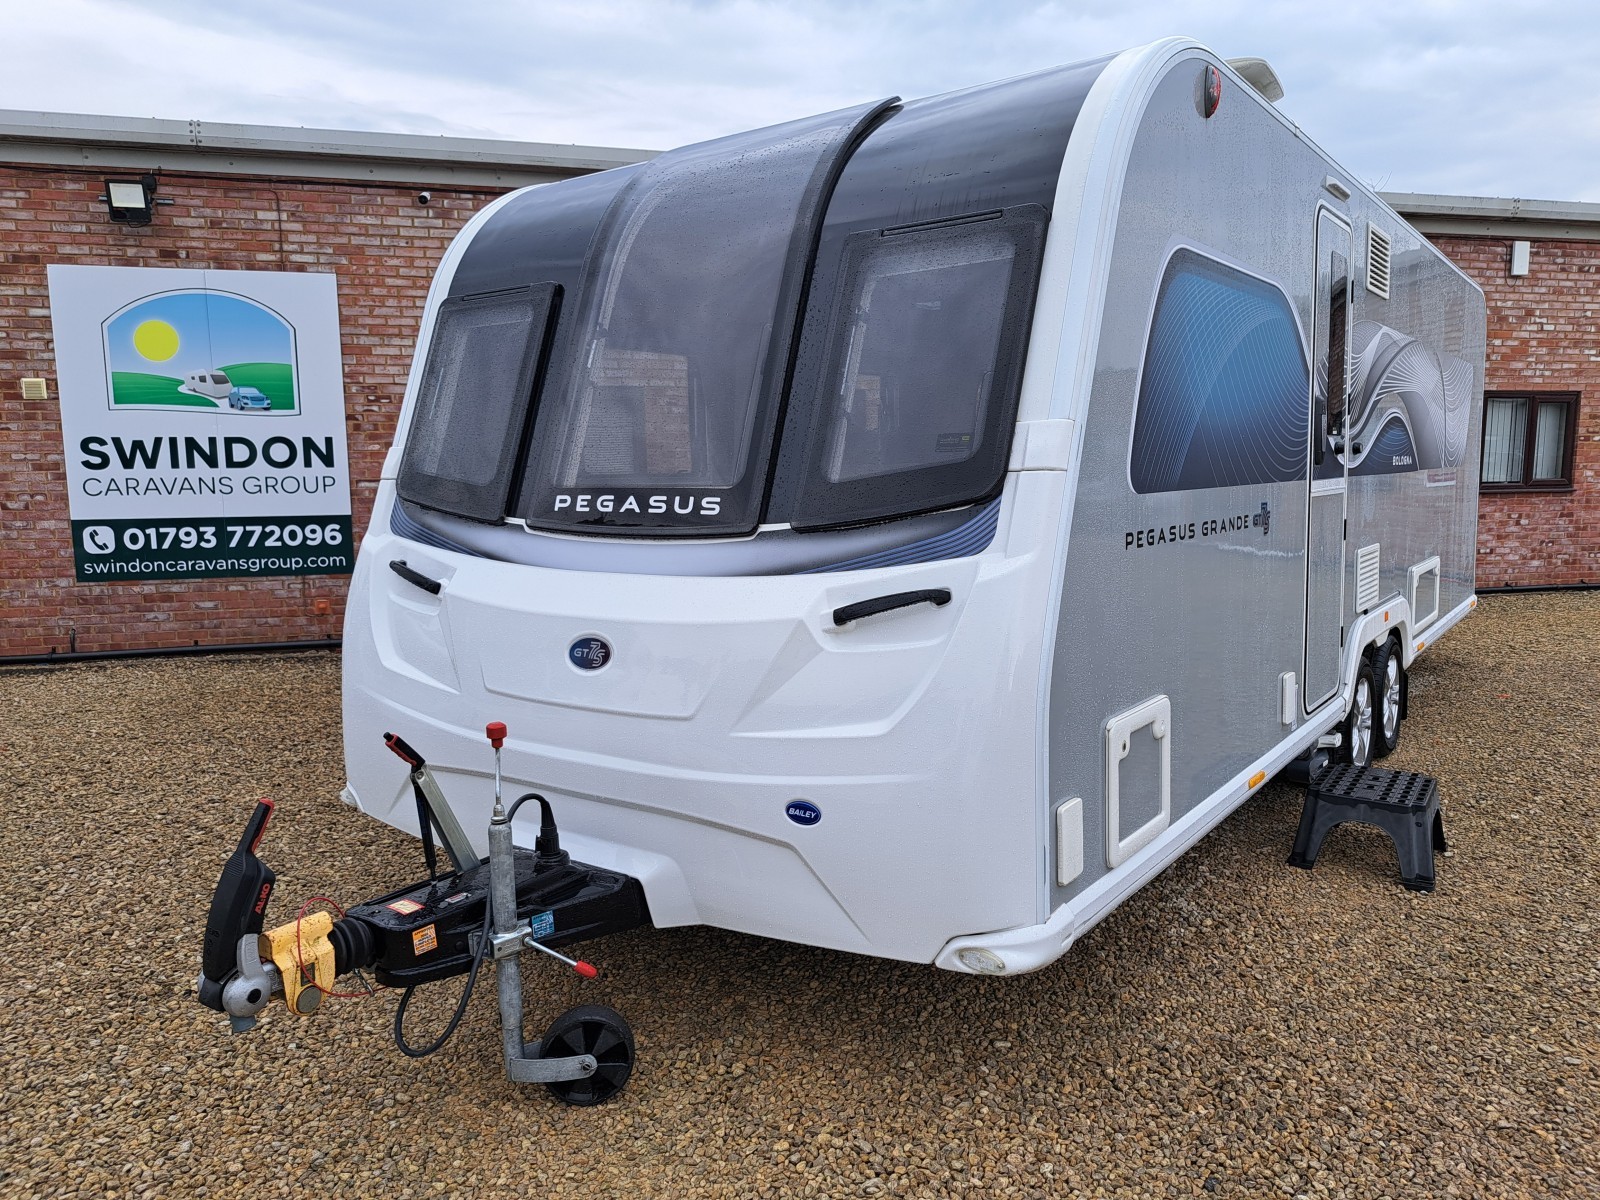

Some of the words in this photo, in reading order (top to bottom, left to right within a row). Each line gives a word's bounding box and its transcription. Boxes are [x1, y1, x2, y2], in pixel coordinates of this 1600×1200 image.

[79, 436, 335, 470] SWINDON
[1392, 455, 1413, 466] BOLOGNA
[82, 476, 234, 497] CARAVANS
[242, 475, 336, 495] GROUP
[554, 494, 721, 516] PEGASUS
[123, 526, 217, 551] 01793
[226, 524, 343, 548] 772096
[1125, 522, 1196, 550] PEGASUS
[1201, 514, 1249, 537] GRANDE
[84, 555, 346, 575] swindoncaravansgroup.com
[788, 807, 817, 819] BAILEY
